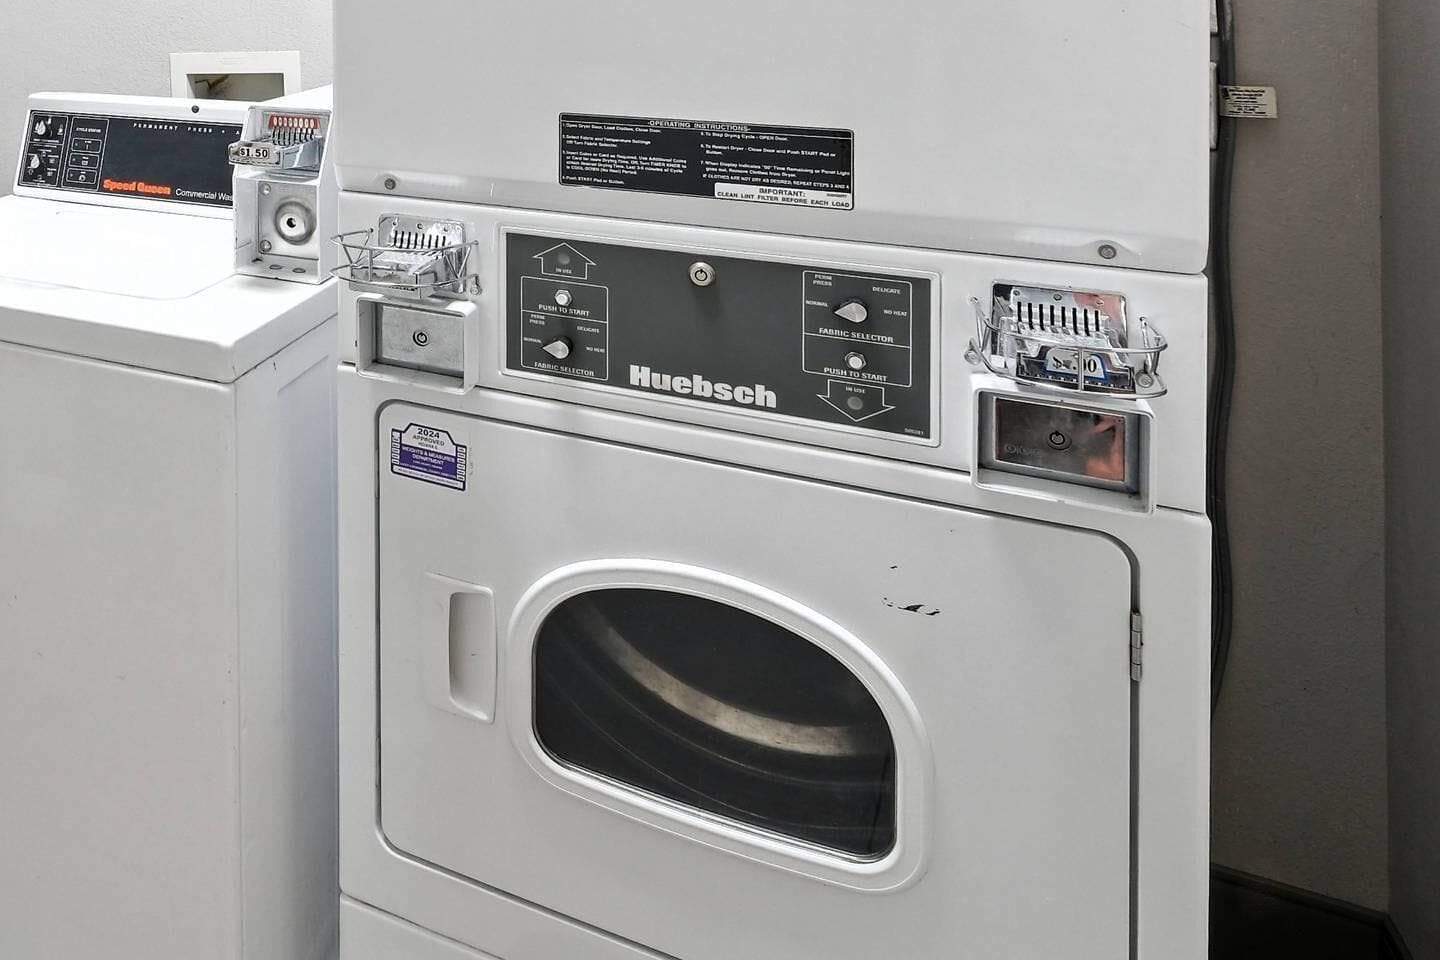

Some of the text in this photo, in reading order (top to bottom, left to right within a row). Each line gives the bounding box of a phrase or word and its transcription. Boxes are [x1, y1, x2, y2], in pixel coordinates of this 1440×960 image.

[103, 178, 137, 192] Speed
[137, 181, 171, 195] Queen
[175, 188, 217, 200] Commercial
[717, 191, 739, 199] CLEAN
[757, 194, 779, 202] FILTER
[781, 196, 808, 205] BEFORE
[810, 199, 830, 207] EACH
[831, 201, 851, 209] LOAD
[872, 286, 902, 295] DELICATE
[538, 304, 590, 317] PUSH TO START
[577, 326, 600, 334] DELICATE
[818, 327, 895, 343] FABRIC SELECTOR
[534, 361, 595, 377] FABRIC SELECTOR
[824, 367, 888, 382] PUSH TO START
[629, 363, 777, 409] Huebsch
[413, 434, 445, 447] APPROVED
[417, 427, 440, 439] 2024
